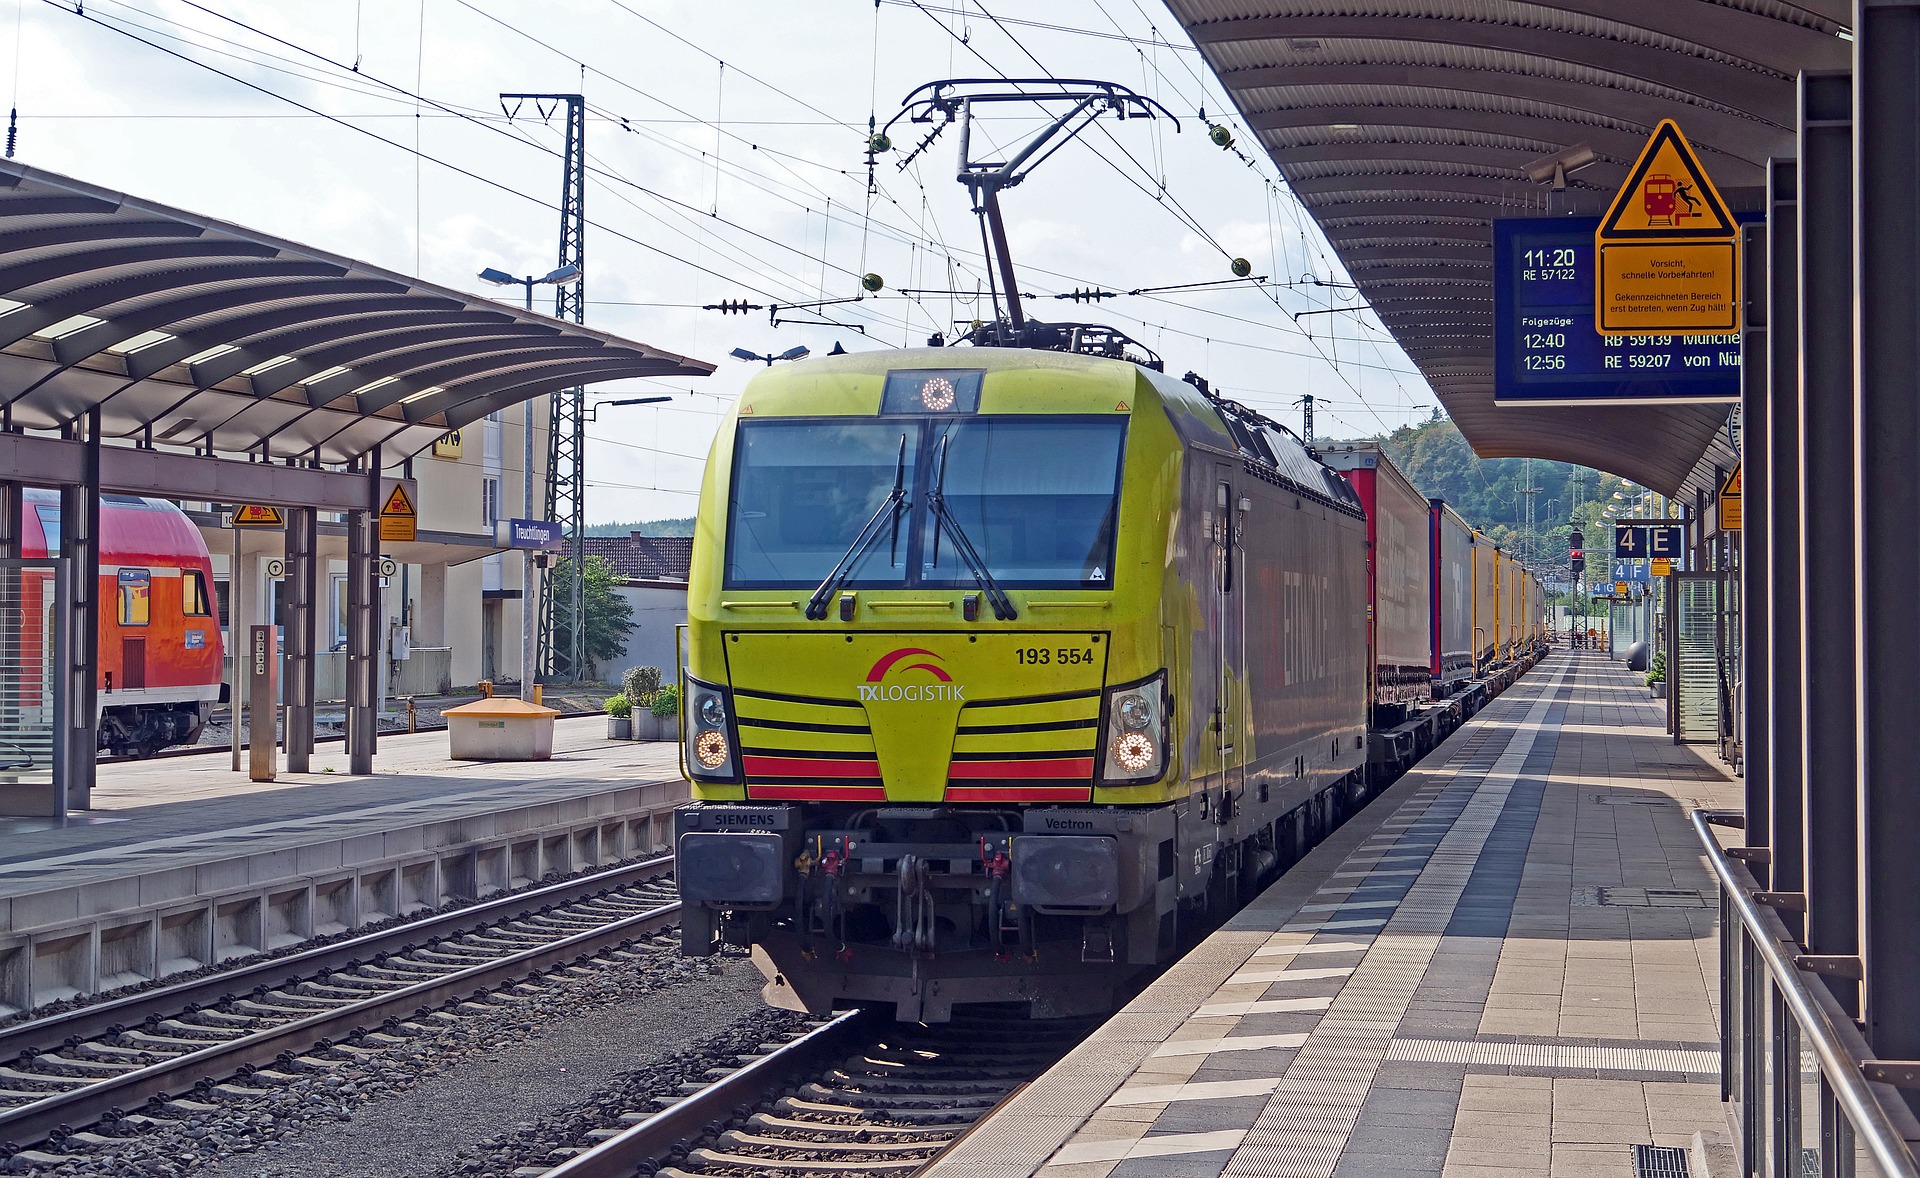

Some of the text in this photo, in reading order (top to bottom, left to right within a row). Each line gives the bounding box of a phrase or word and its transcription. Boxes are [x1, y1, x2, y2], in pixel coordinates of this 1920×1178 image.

[1524, 249, 1575, 267] 11:20
[1650, 260, 1686, 268] Vorsicht,
[1523, 269, 1575, 281] RE 57122
[1621, 270, 1715, 279] schnelle Vorbeifahrten!
[1615, 292, 1722, 302] Gekennzeichneten Bereich
[1628, 304, 1664, 313] betreten,
[1690, 303, 1706, 313] Zug
[1707, 303, 1726, 312] hält!
[1522, 317, 1574, 328] Folgezüge:
[1524, 333, 1565, 349] 12:40
[1524, 355, 1565, 370] 12:56
[1604, 355, 1623, 368] RE
[1629, 354, 1671, 368] 59207
[1683, 356, 1711, 367] von
[514, 523, 550, 545] Treuchtlingen
[1620, 528, 1669, 552] 4 E
[1615, 564, 1625, 578] 4
[1633, 565, 1642, 578] F
[1594, 583, 1601, 593] 4
[1606, 583, 1614, 593] G
[1015, 648, 1094, 665] 193 554
[856, 685, 966, 701] TXLOGISTIK
[715, 814, 775, 825] SIEMENS
[1045, 818, 1094, 829] Vectron
